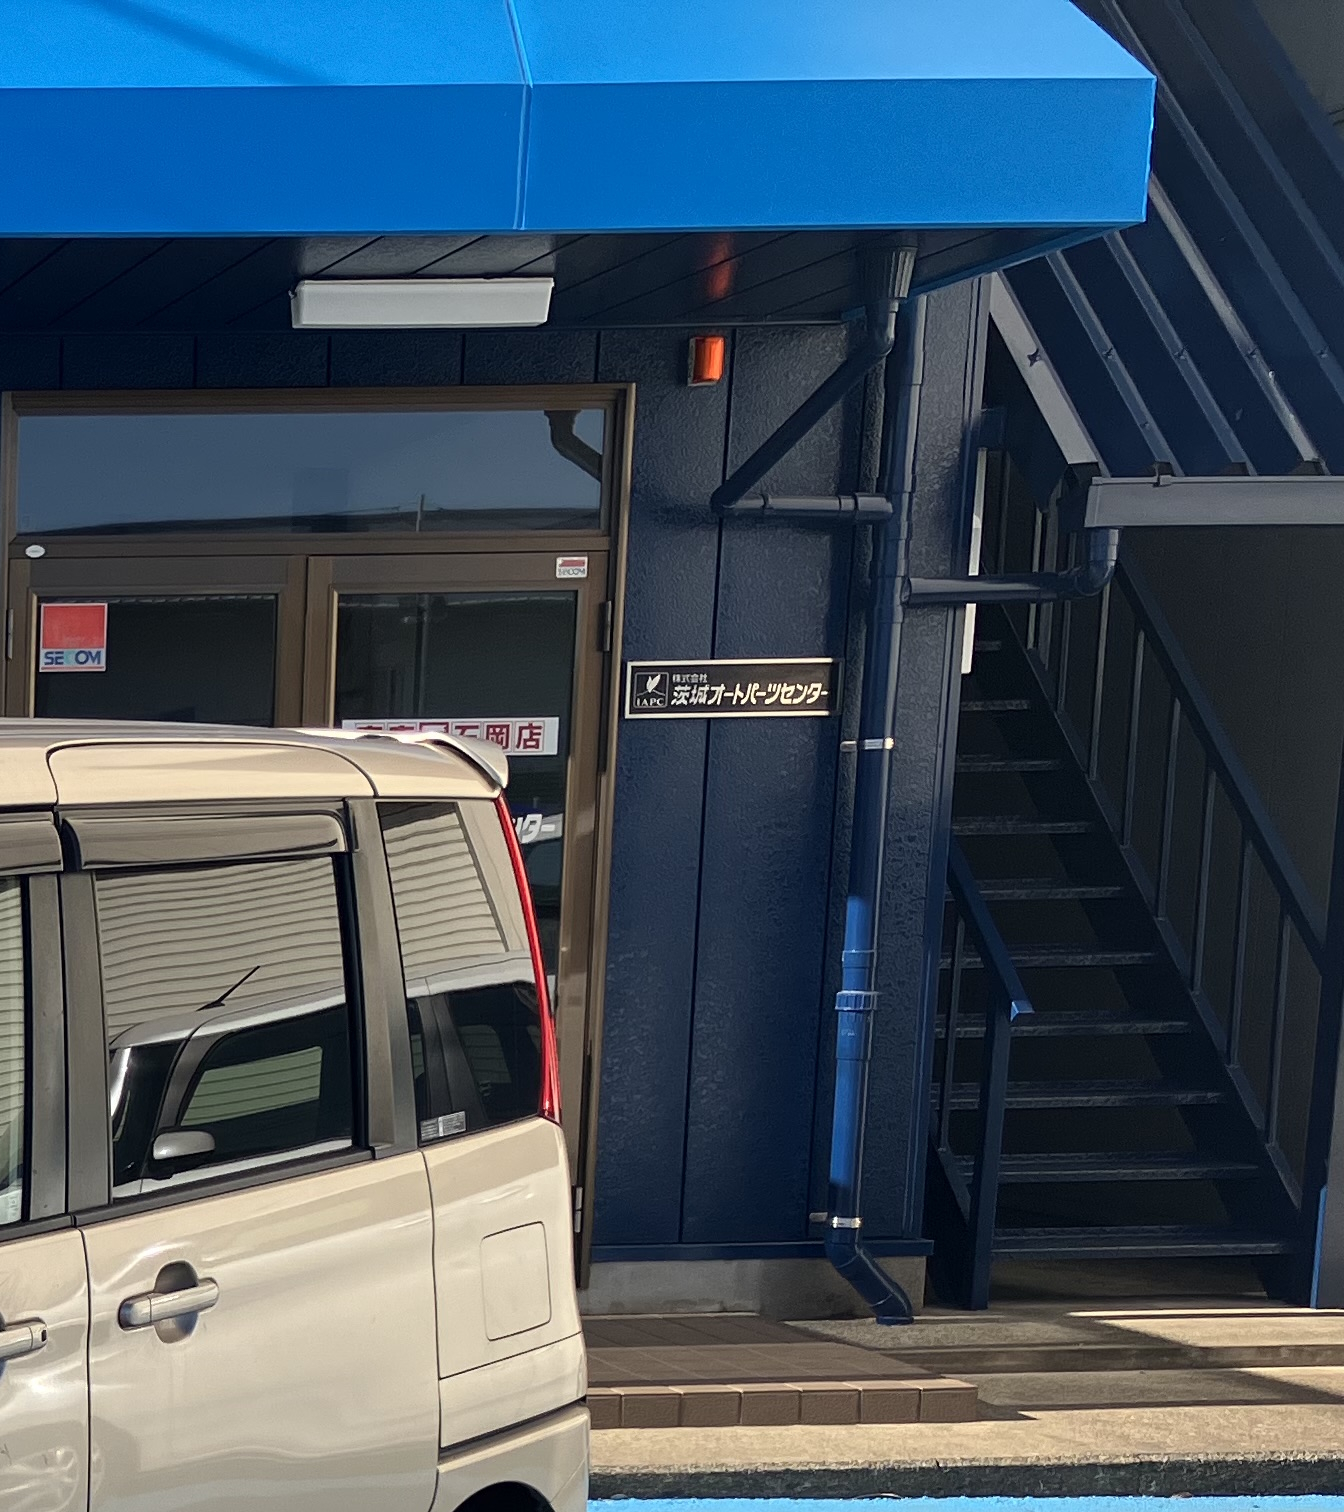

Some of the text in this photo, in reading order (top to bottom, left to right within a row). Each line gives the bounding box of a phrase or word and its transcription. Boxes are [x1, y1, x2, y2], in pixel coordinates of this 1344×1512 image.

[44, 650, 102, 665] SECOM
[672, 673, 708, 683] 株式会社
[671, 682, 829, 706] 茨城オートパーツセンター
